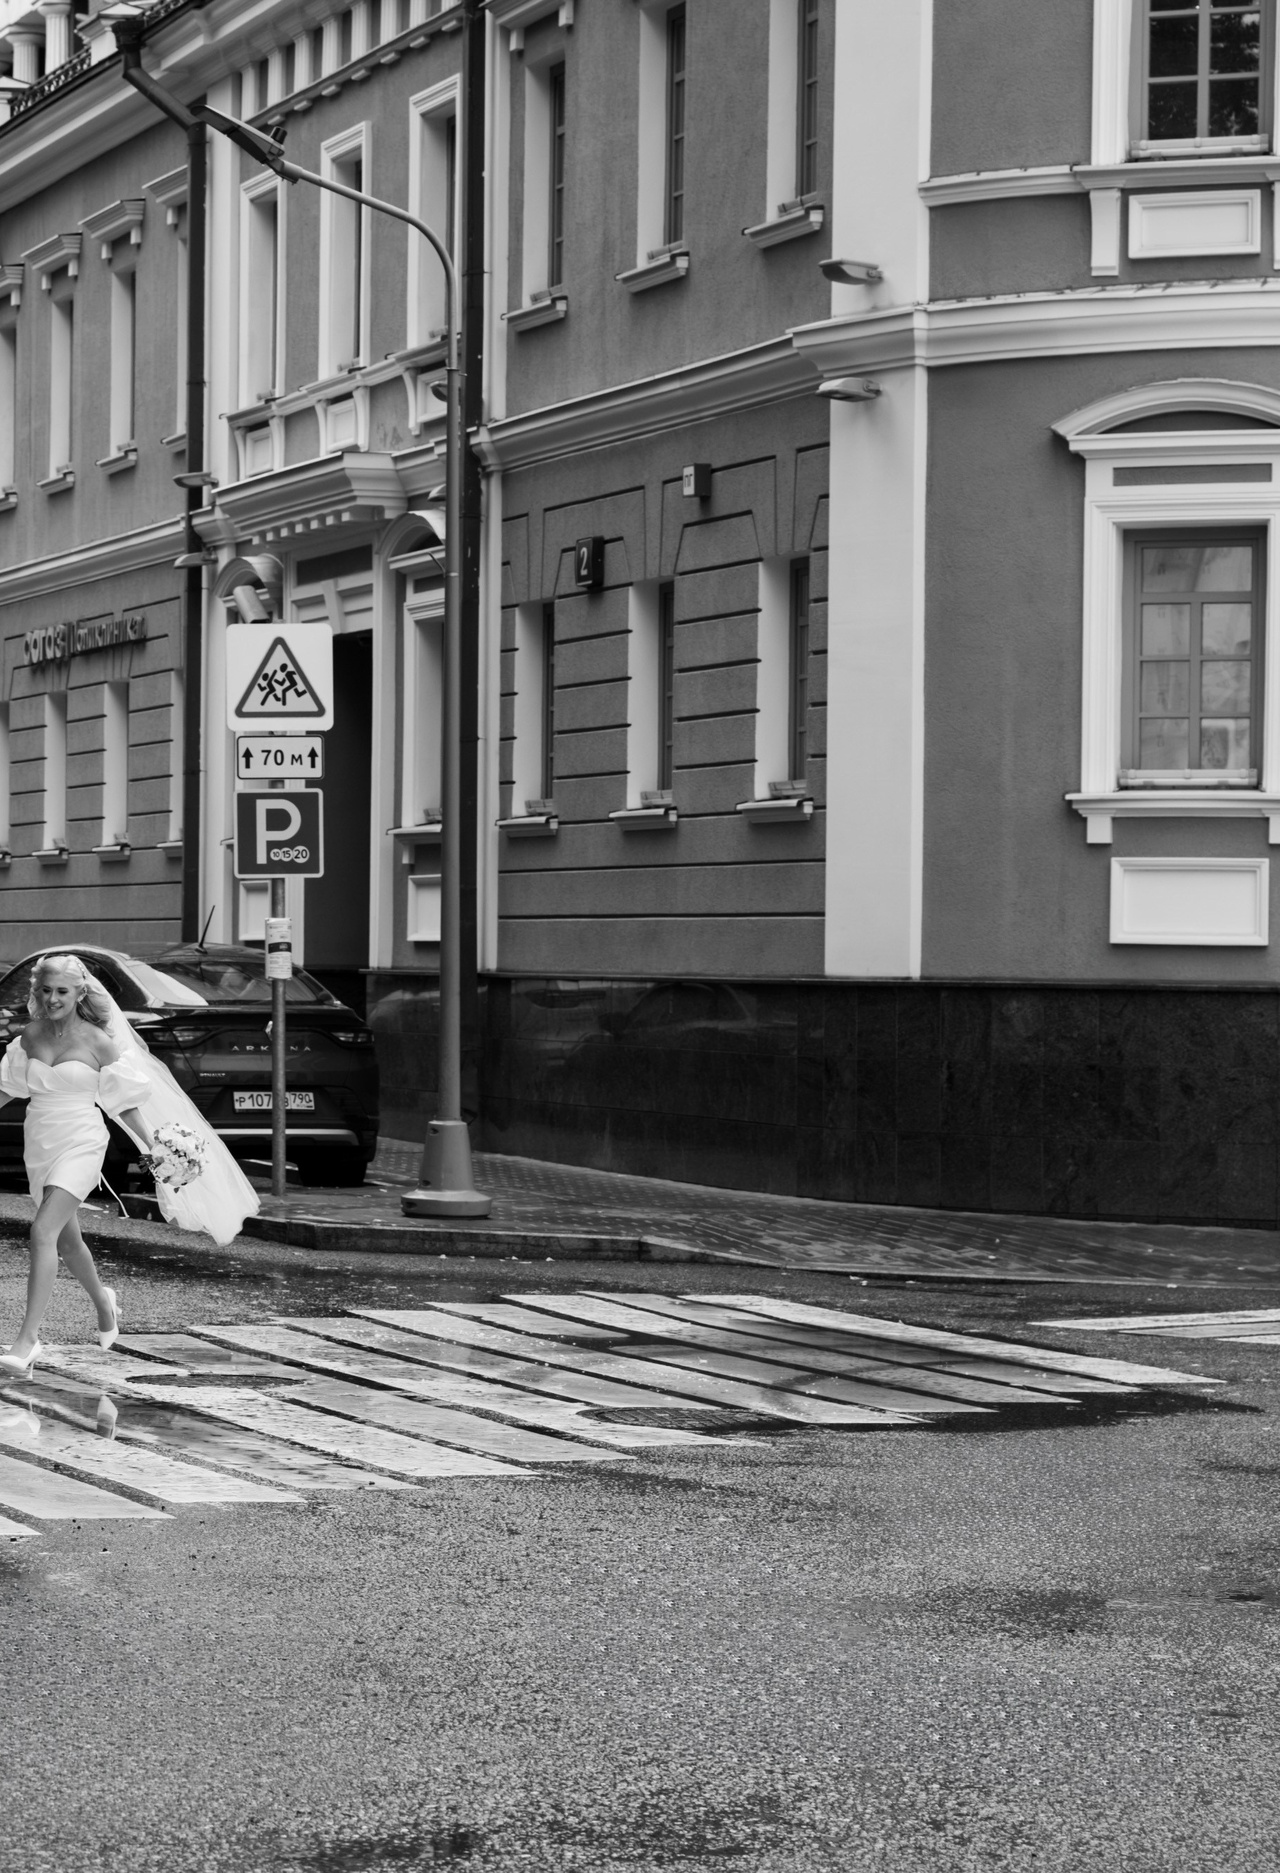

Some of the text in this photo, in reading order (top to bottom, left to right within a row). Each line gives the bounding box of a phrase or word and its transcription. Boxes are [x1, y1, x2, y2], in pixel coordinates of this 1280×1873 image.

[580, 547, 588, 576] 2
[261, 749, 285, 766] 70
[256, 799, 302, 865] P
[272, 849, 308, 860] 10 15 20
